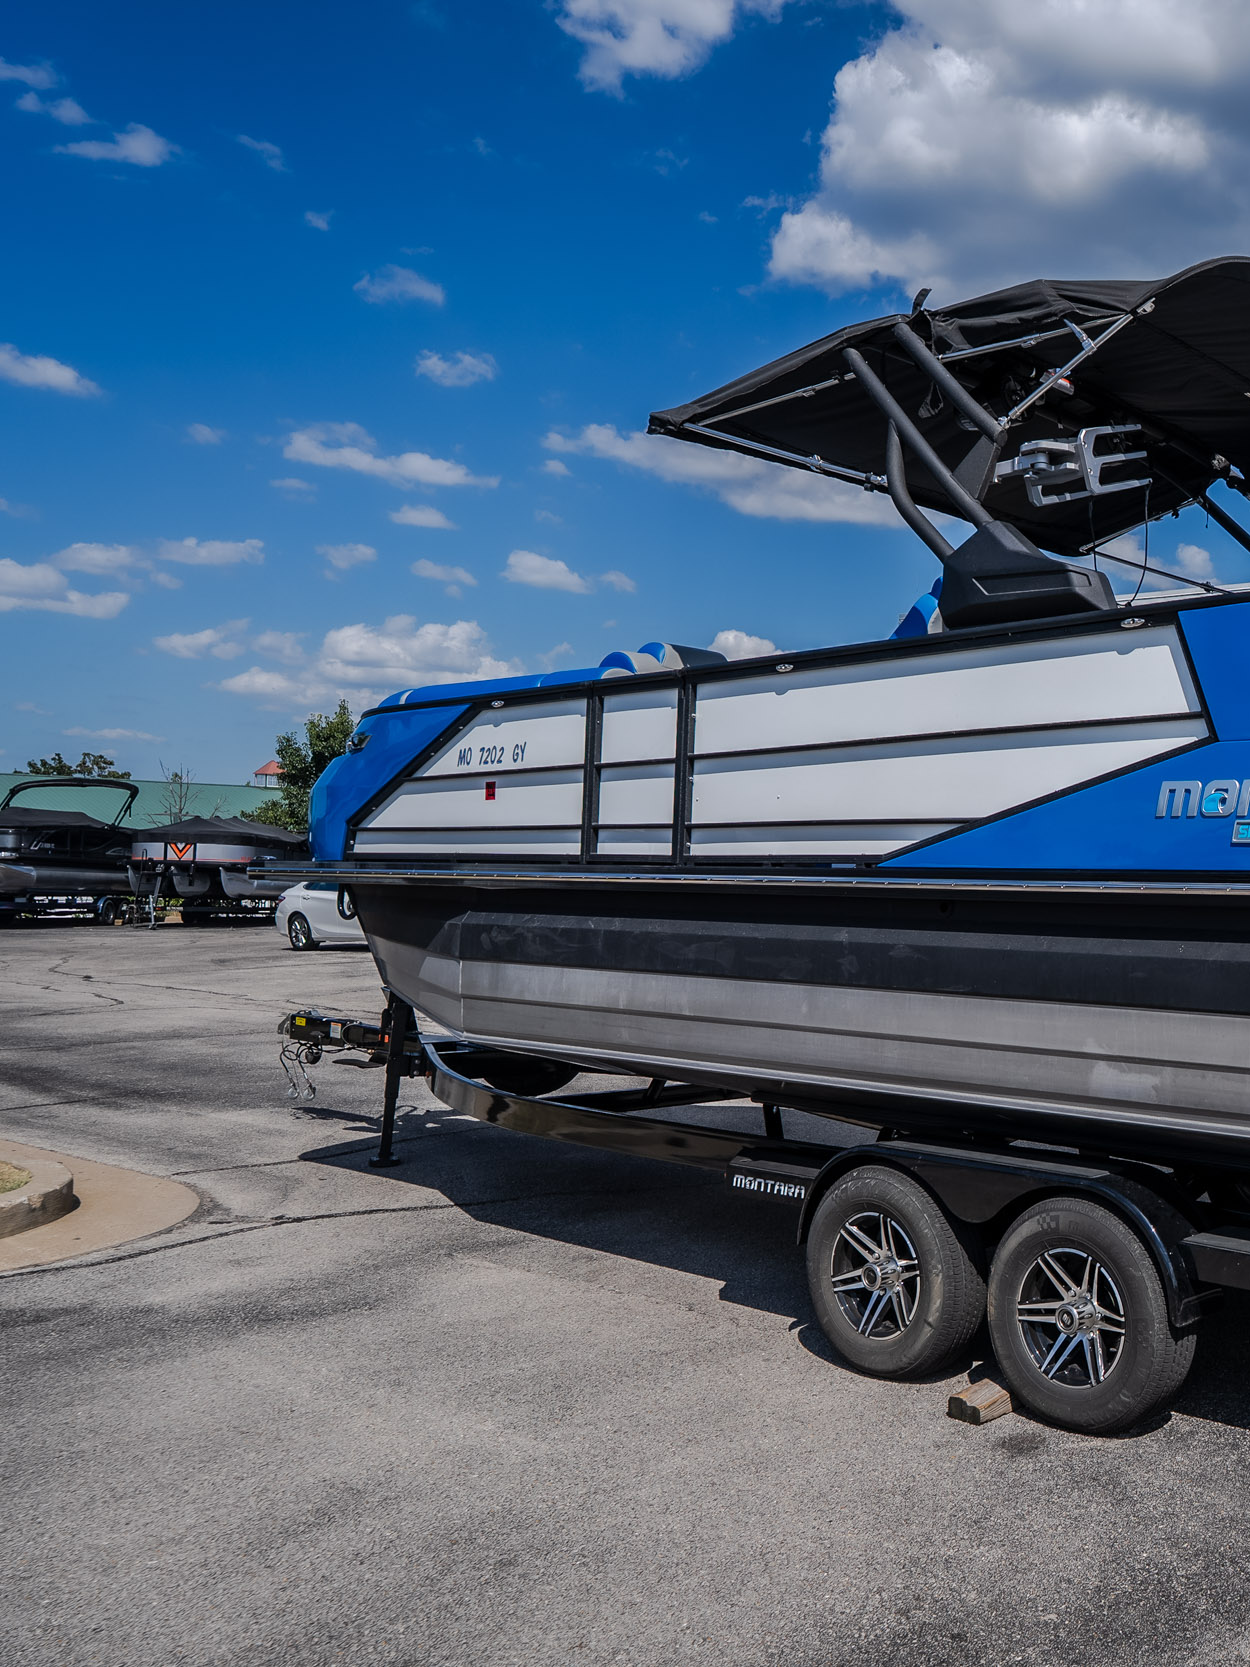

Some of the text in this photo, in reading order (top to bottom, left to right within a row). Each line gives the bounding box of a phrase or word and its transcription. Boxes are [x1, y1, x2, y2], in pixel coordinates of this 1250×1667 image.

[457, 741, 527, 767] MO 7202 GY
[732, 1174, 806, 1199] MONTARA
